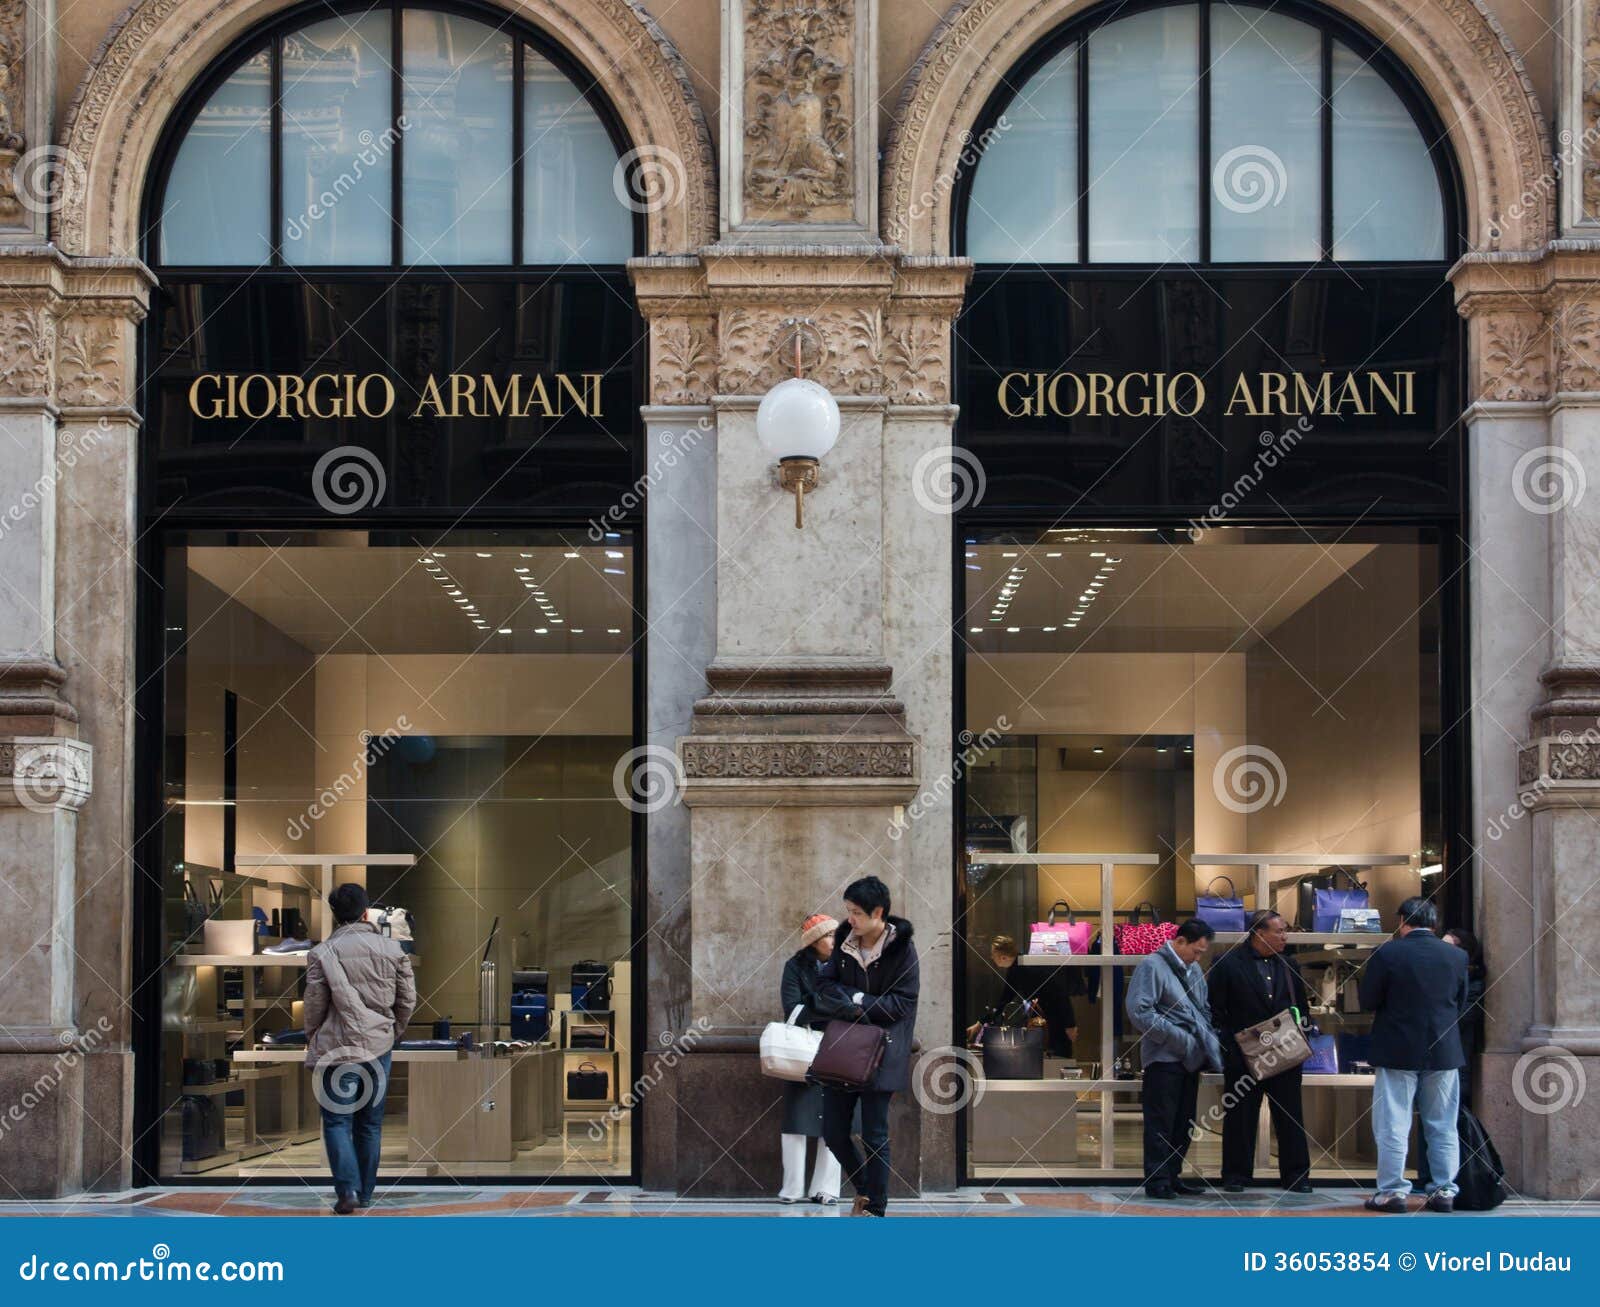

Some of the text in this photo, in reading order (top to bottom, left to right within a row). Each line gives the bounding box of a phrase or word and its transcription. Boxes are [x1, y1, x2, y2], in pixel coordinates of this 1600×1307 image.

[189, 373, 604, 420] GIORGIO ARMANI
[997, 371, 1416, 418] GIORGIO ARMANI
